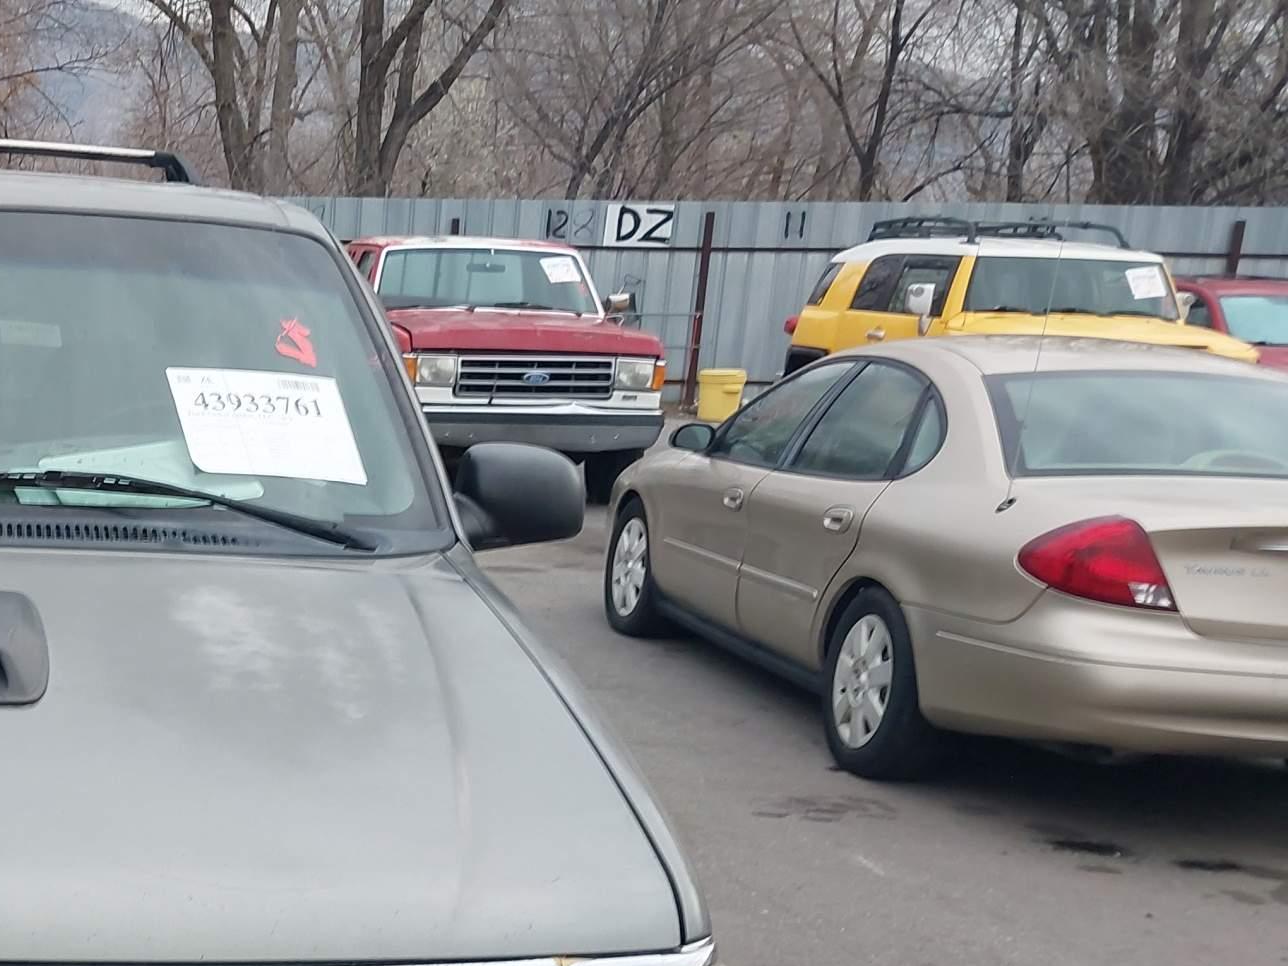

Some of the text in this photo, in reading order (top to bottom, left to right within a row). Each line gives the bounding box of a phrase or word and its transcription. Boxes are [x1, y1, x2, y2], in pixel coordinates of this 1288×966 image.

[545, 208, 569, 239] 12
[615, 205, 675, 245] DZ
[784, 210, 807, 240] 11
[193, 390, 324, 418] 43933761
